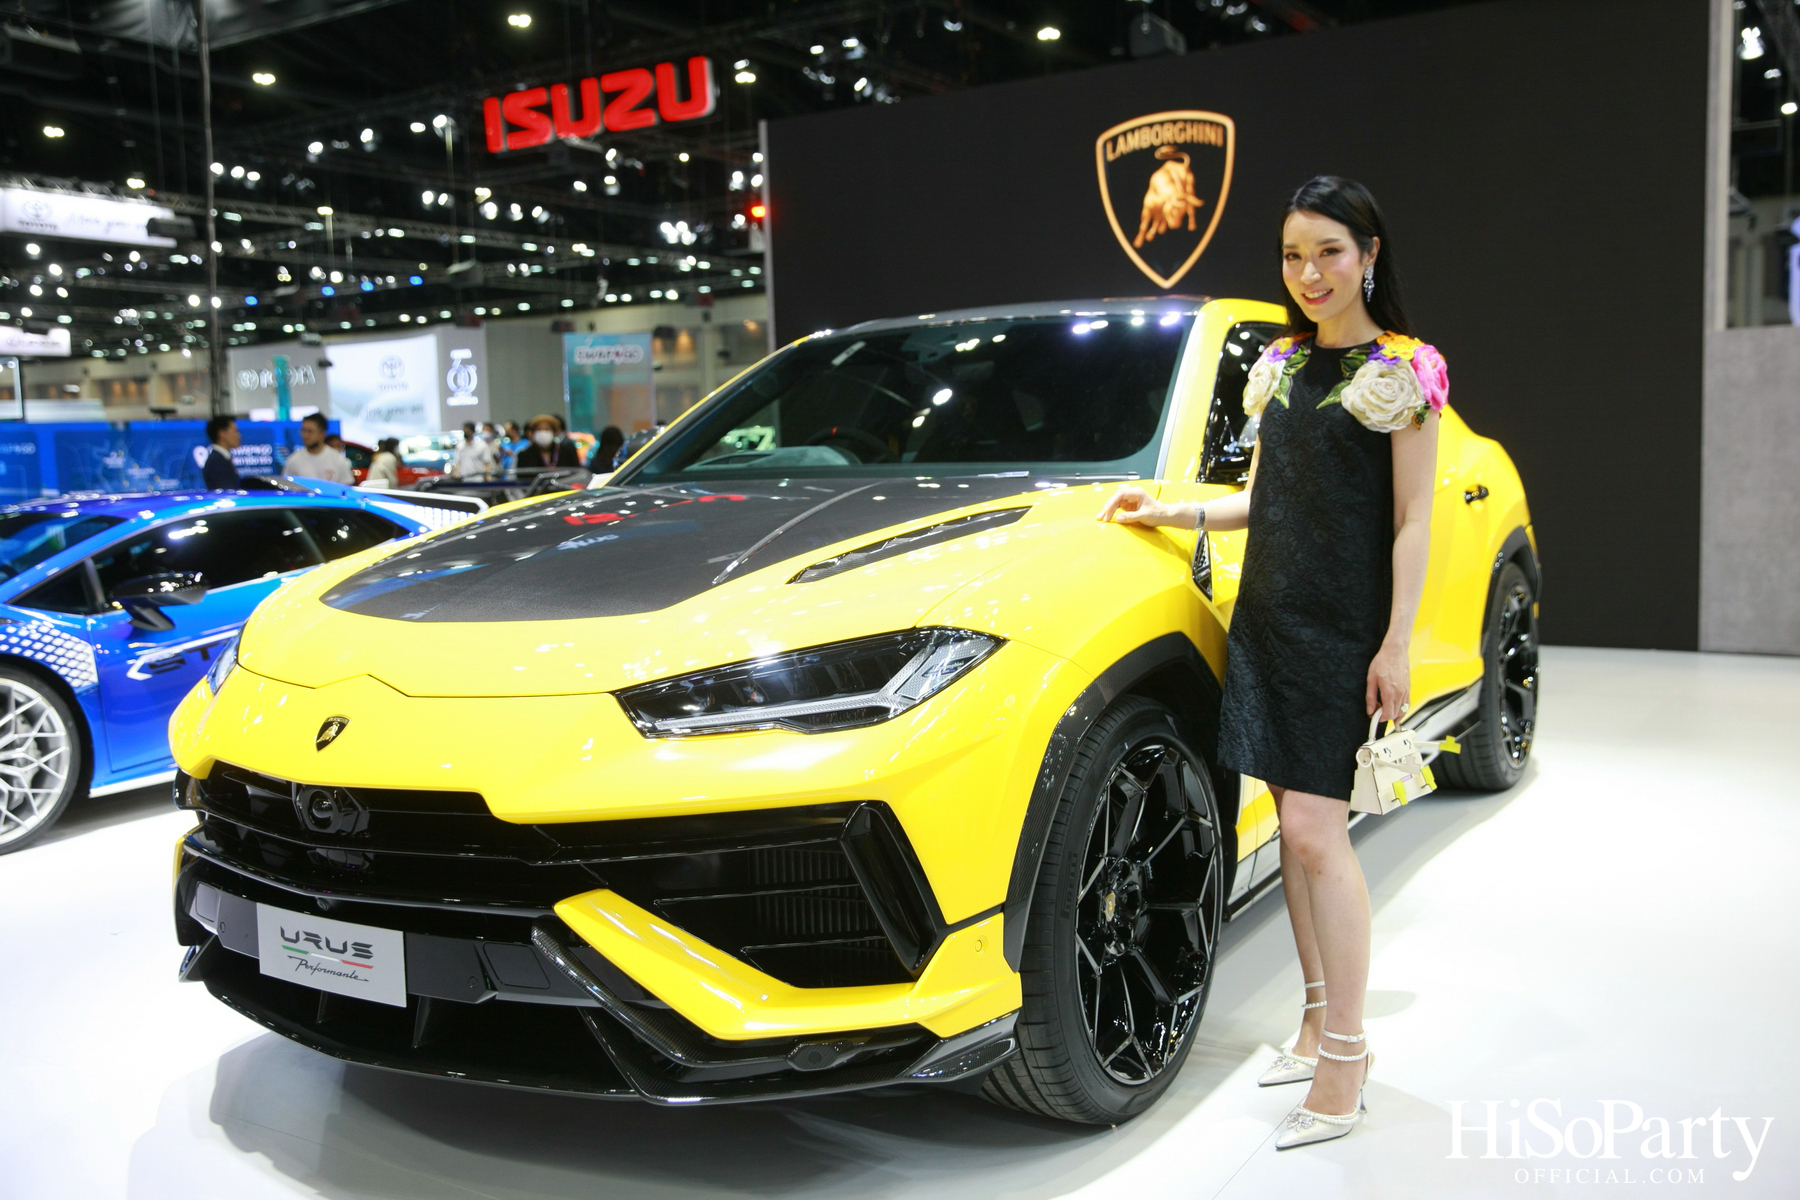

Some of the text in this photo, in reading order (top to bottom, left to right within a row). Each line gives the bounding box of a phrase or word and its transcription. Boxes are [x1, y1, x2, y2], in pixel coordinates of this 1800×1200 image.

[483, 55, 716, 153] ISUZU
[1106, 120, 1224, 162] LAMBORGHINI
[148, 640, 227, 675] ST
[280, 925, 374, 960] URUS
[287, 955, 369, 982] Performante
